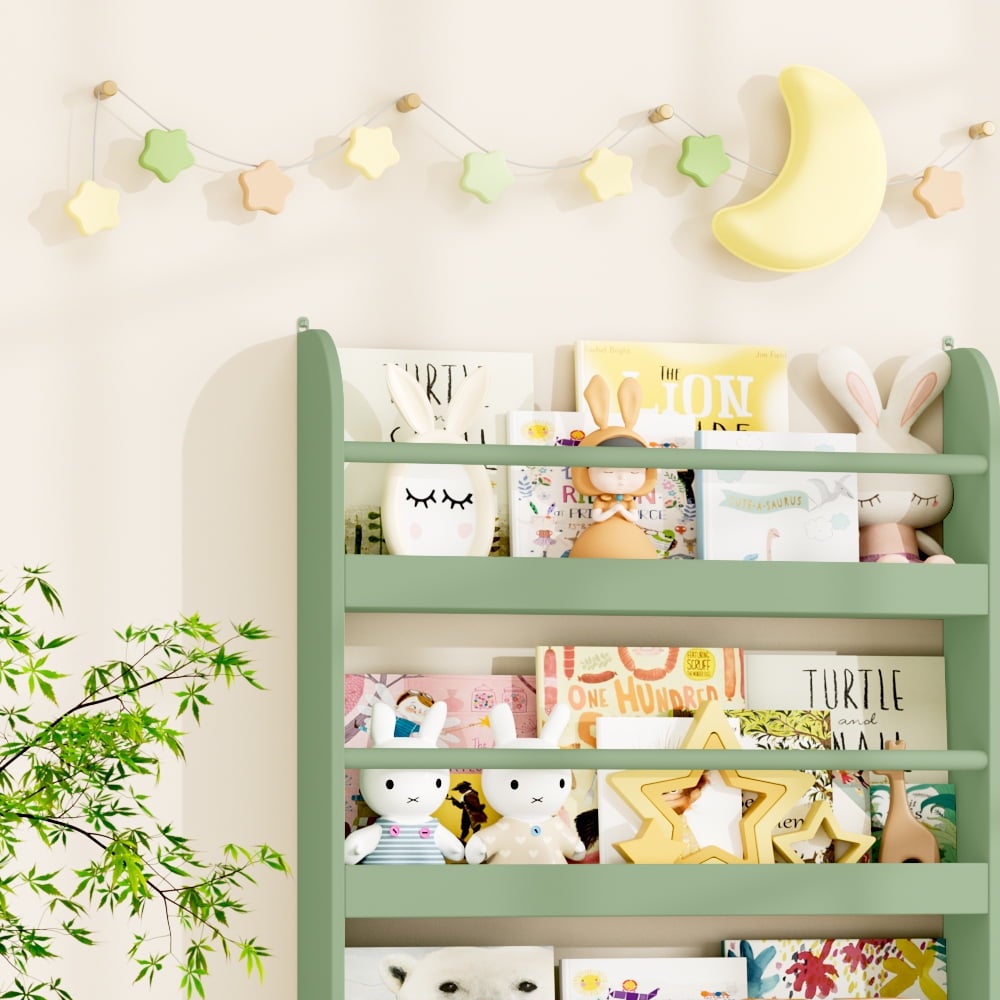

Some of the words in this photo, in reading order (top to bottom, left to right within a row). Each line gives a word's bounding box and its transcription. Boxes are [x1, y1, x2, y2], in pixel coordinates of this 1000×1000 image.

[660, 366, 679, 381] THE
[728, 495, 802, 511] CUTE-A-SAURUS
[686, 658, 711, 671] SCRUFF
[567, 684, 608, 711] ONE
[613, 675, 719, 715] HUNDRED
[802, 668, 904, 711] TURTLE
[838, 712, 879, 726] and
